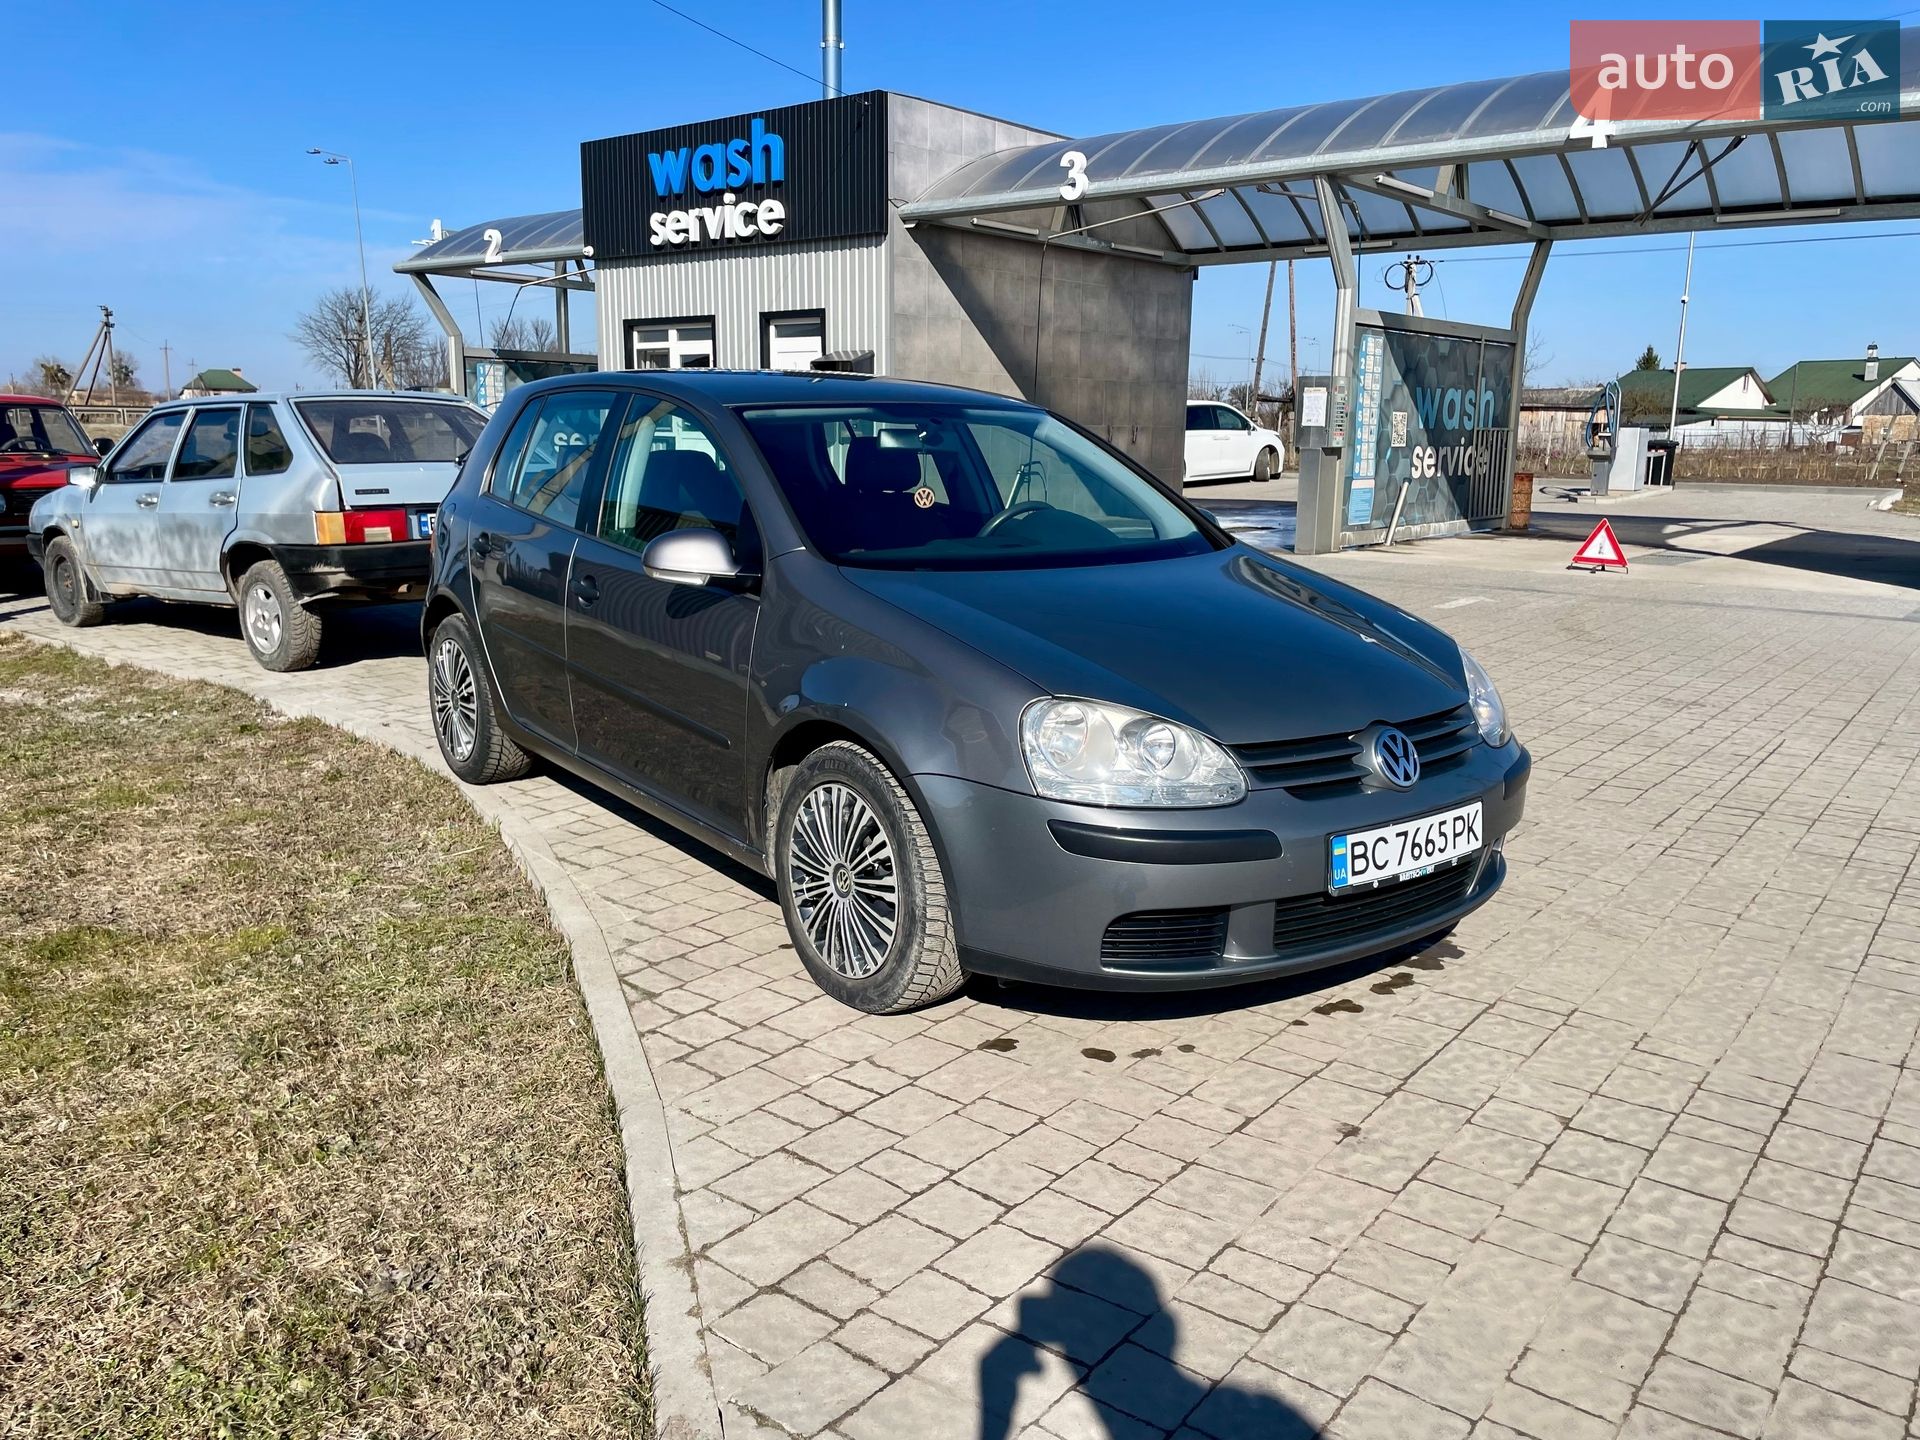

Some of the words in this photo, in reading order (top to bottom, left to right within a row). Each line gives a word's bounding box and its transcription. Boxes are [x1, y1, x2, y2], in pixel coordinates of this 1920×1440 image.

[1569, 86, 1617, 149] 4
[648, 118, 785, 197] wash
[1059, 151, 1089, 201] 3
[650, 192, 786, 246] service
[483, 228, 503, 263] 2
[1360, 357, 1365, 370] 2
[1416, 377, 1495, 431] wash
[1334, 869, 1347, 880] UA
